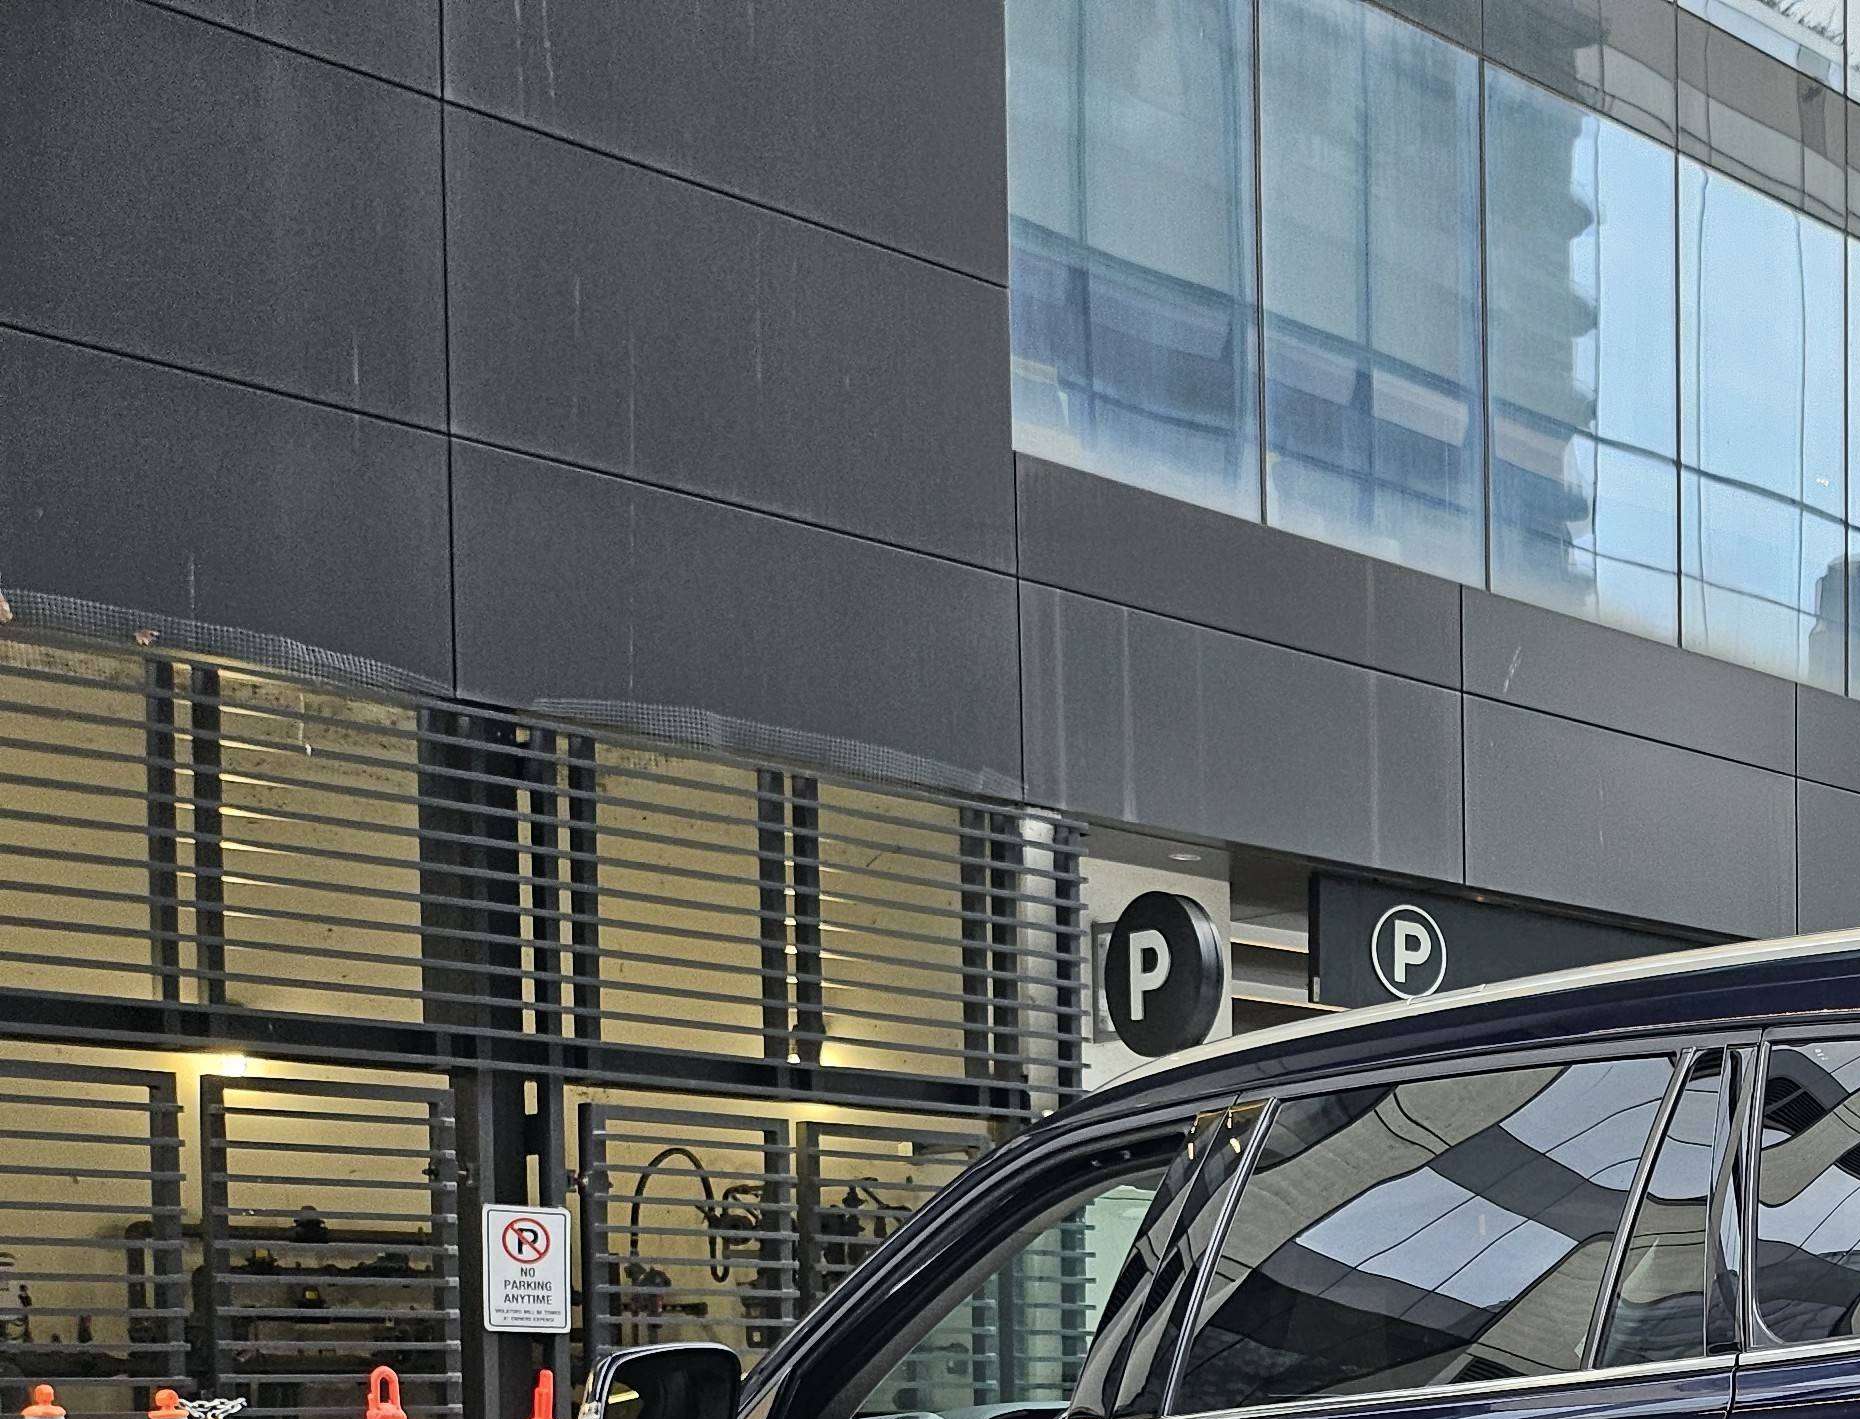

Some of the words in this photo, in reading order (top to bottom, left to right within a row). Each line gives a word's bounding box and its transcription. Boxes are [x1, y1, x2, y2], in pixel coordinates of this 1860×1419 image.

[1393, 919, 1432, 983] P
[1129, 929, 1171, 1021] P
[520, 1266, 536, 1278] NO
[503, 1279, 552, 1292] PARKING
[503, 1293, 552, 1305] ANYTIME
